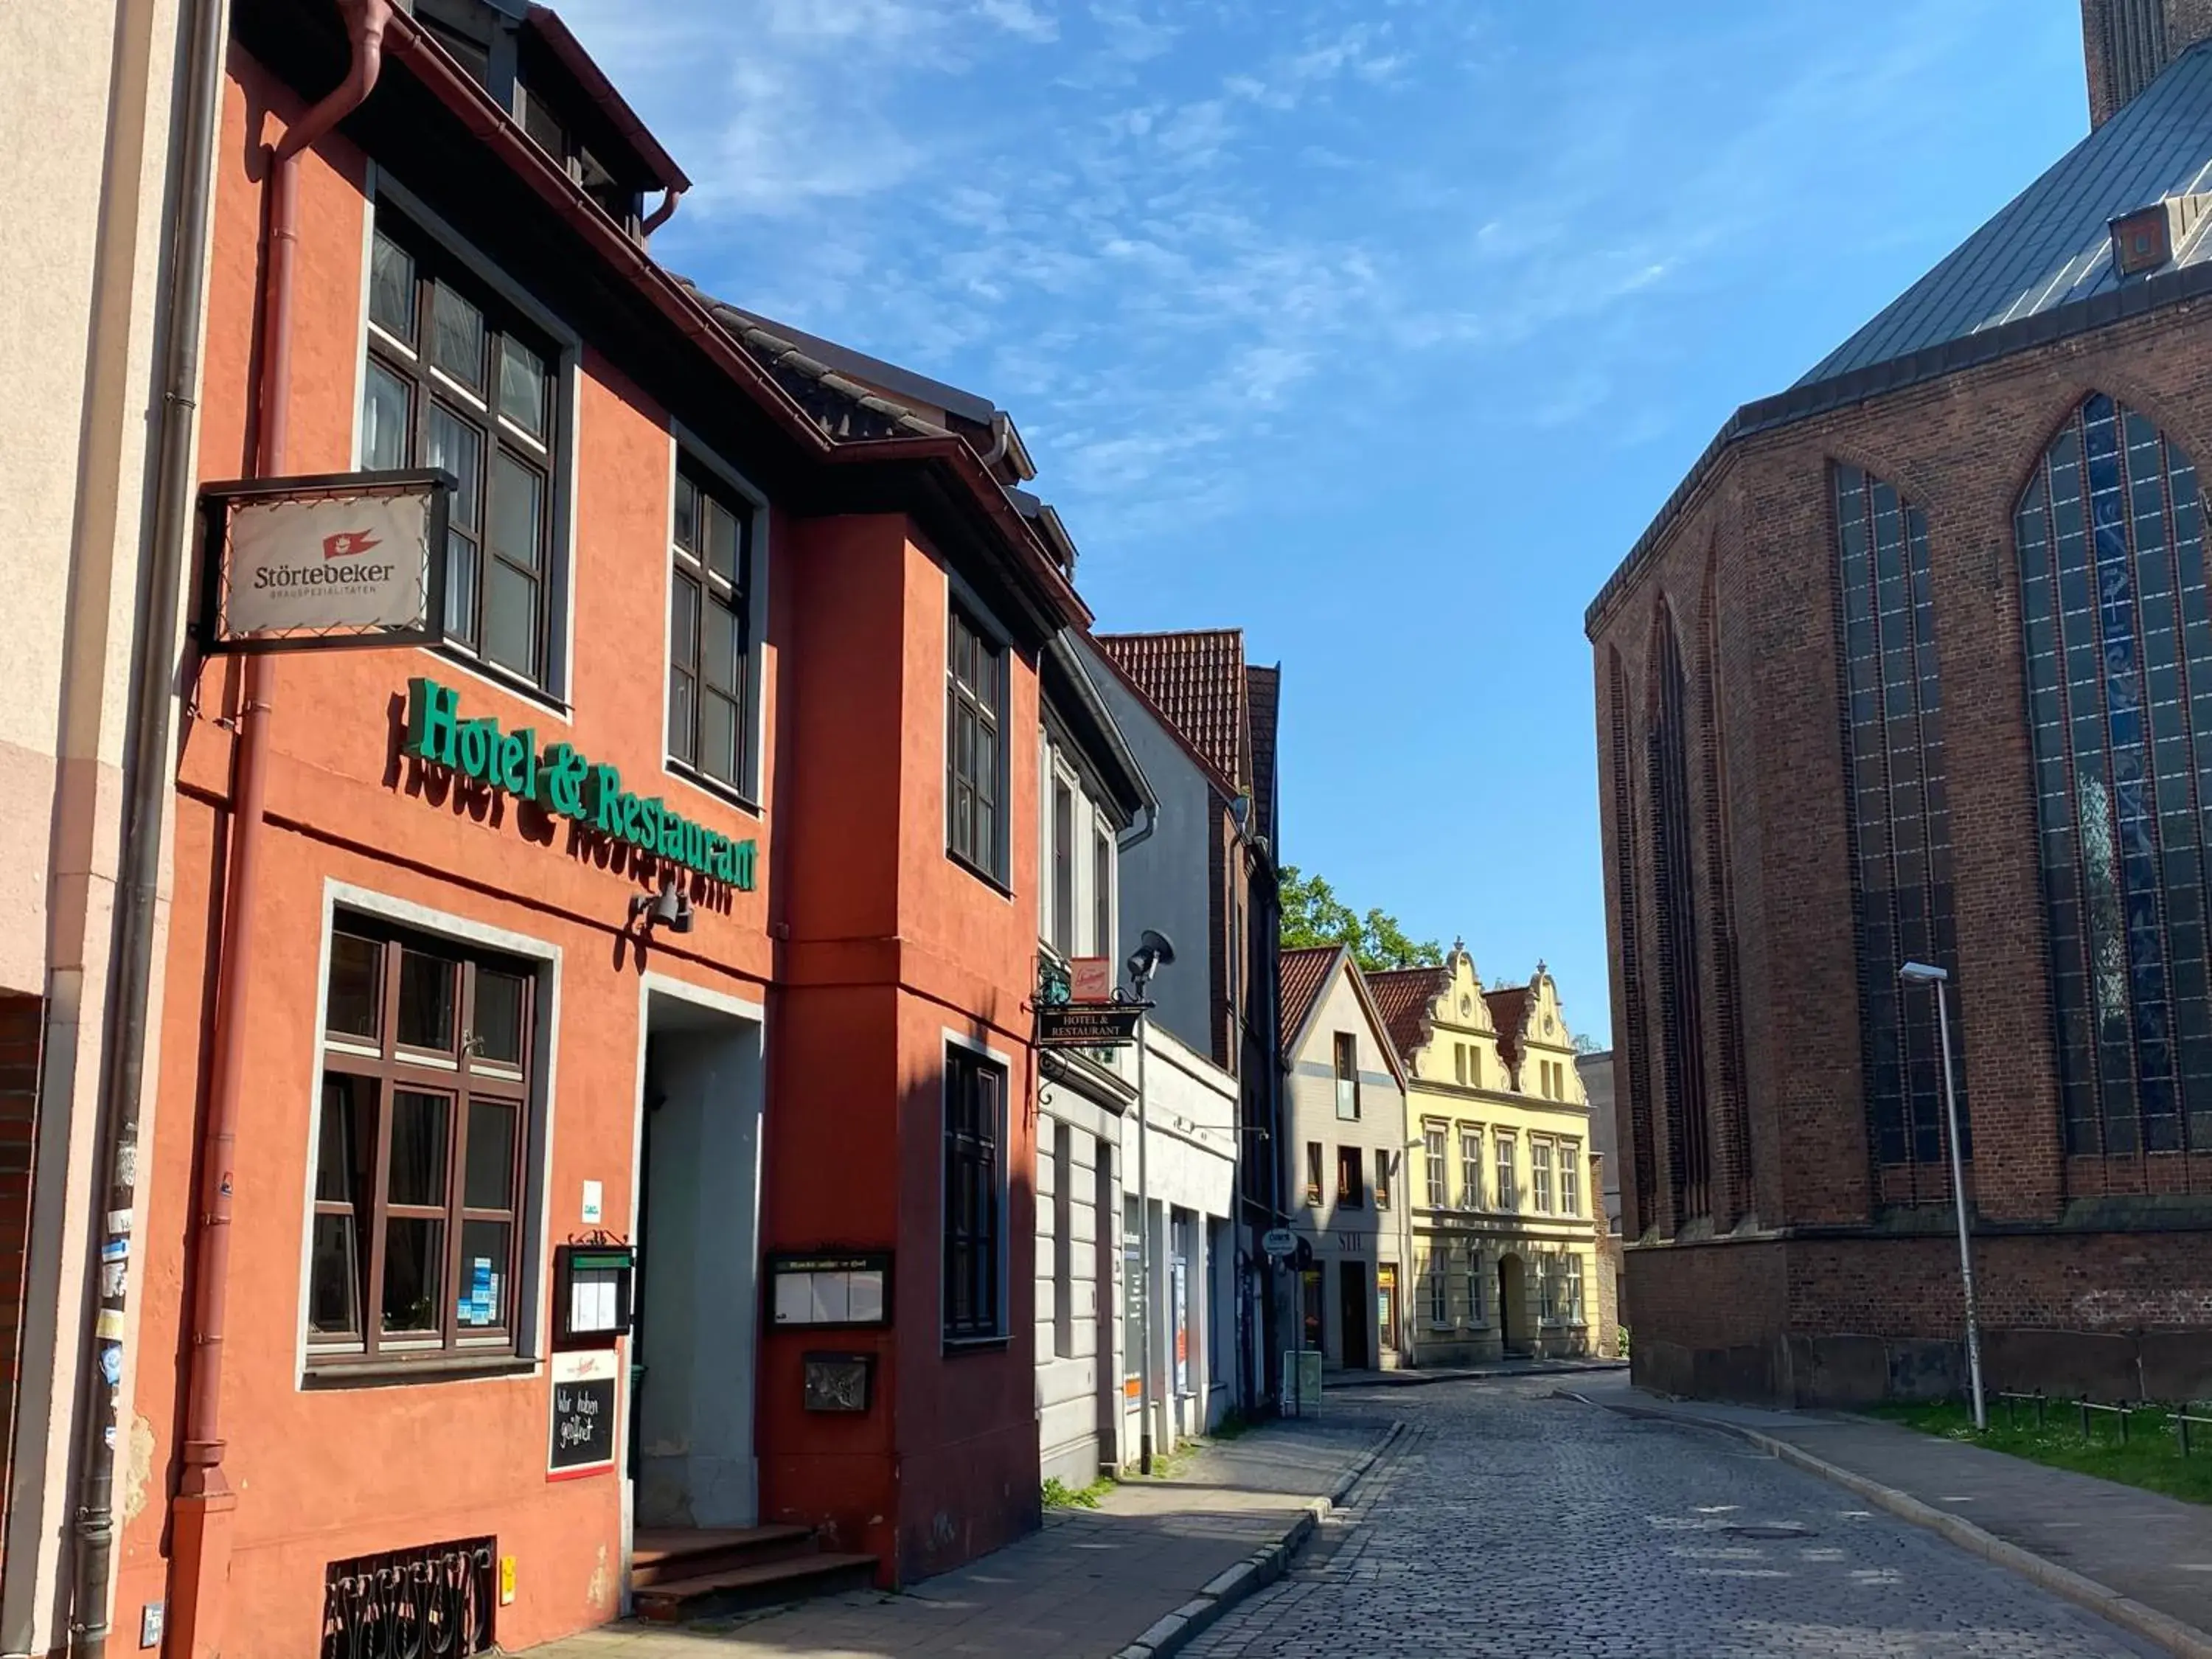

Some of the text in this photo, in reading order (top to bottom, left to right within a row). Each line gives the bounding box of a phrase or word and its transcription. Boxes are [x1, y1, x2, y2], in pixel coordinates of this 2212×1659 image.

[254, 563, 395, 589] Störtebeker
[408, 678, 757, 891] Hotel & Restaurant
[1063, 1015, 1108, 1026] HOTEL &
[1052, 1026, 1120, 1036] RESTAURANT
